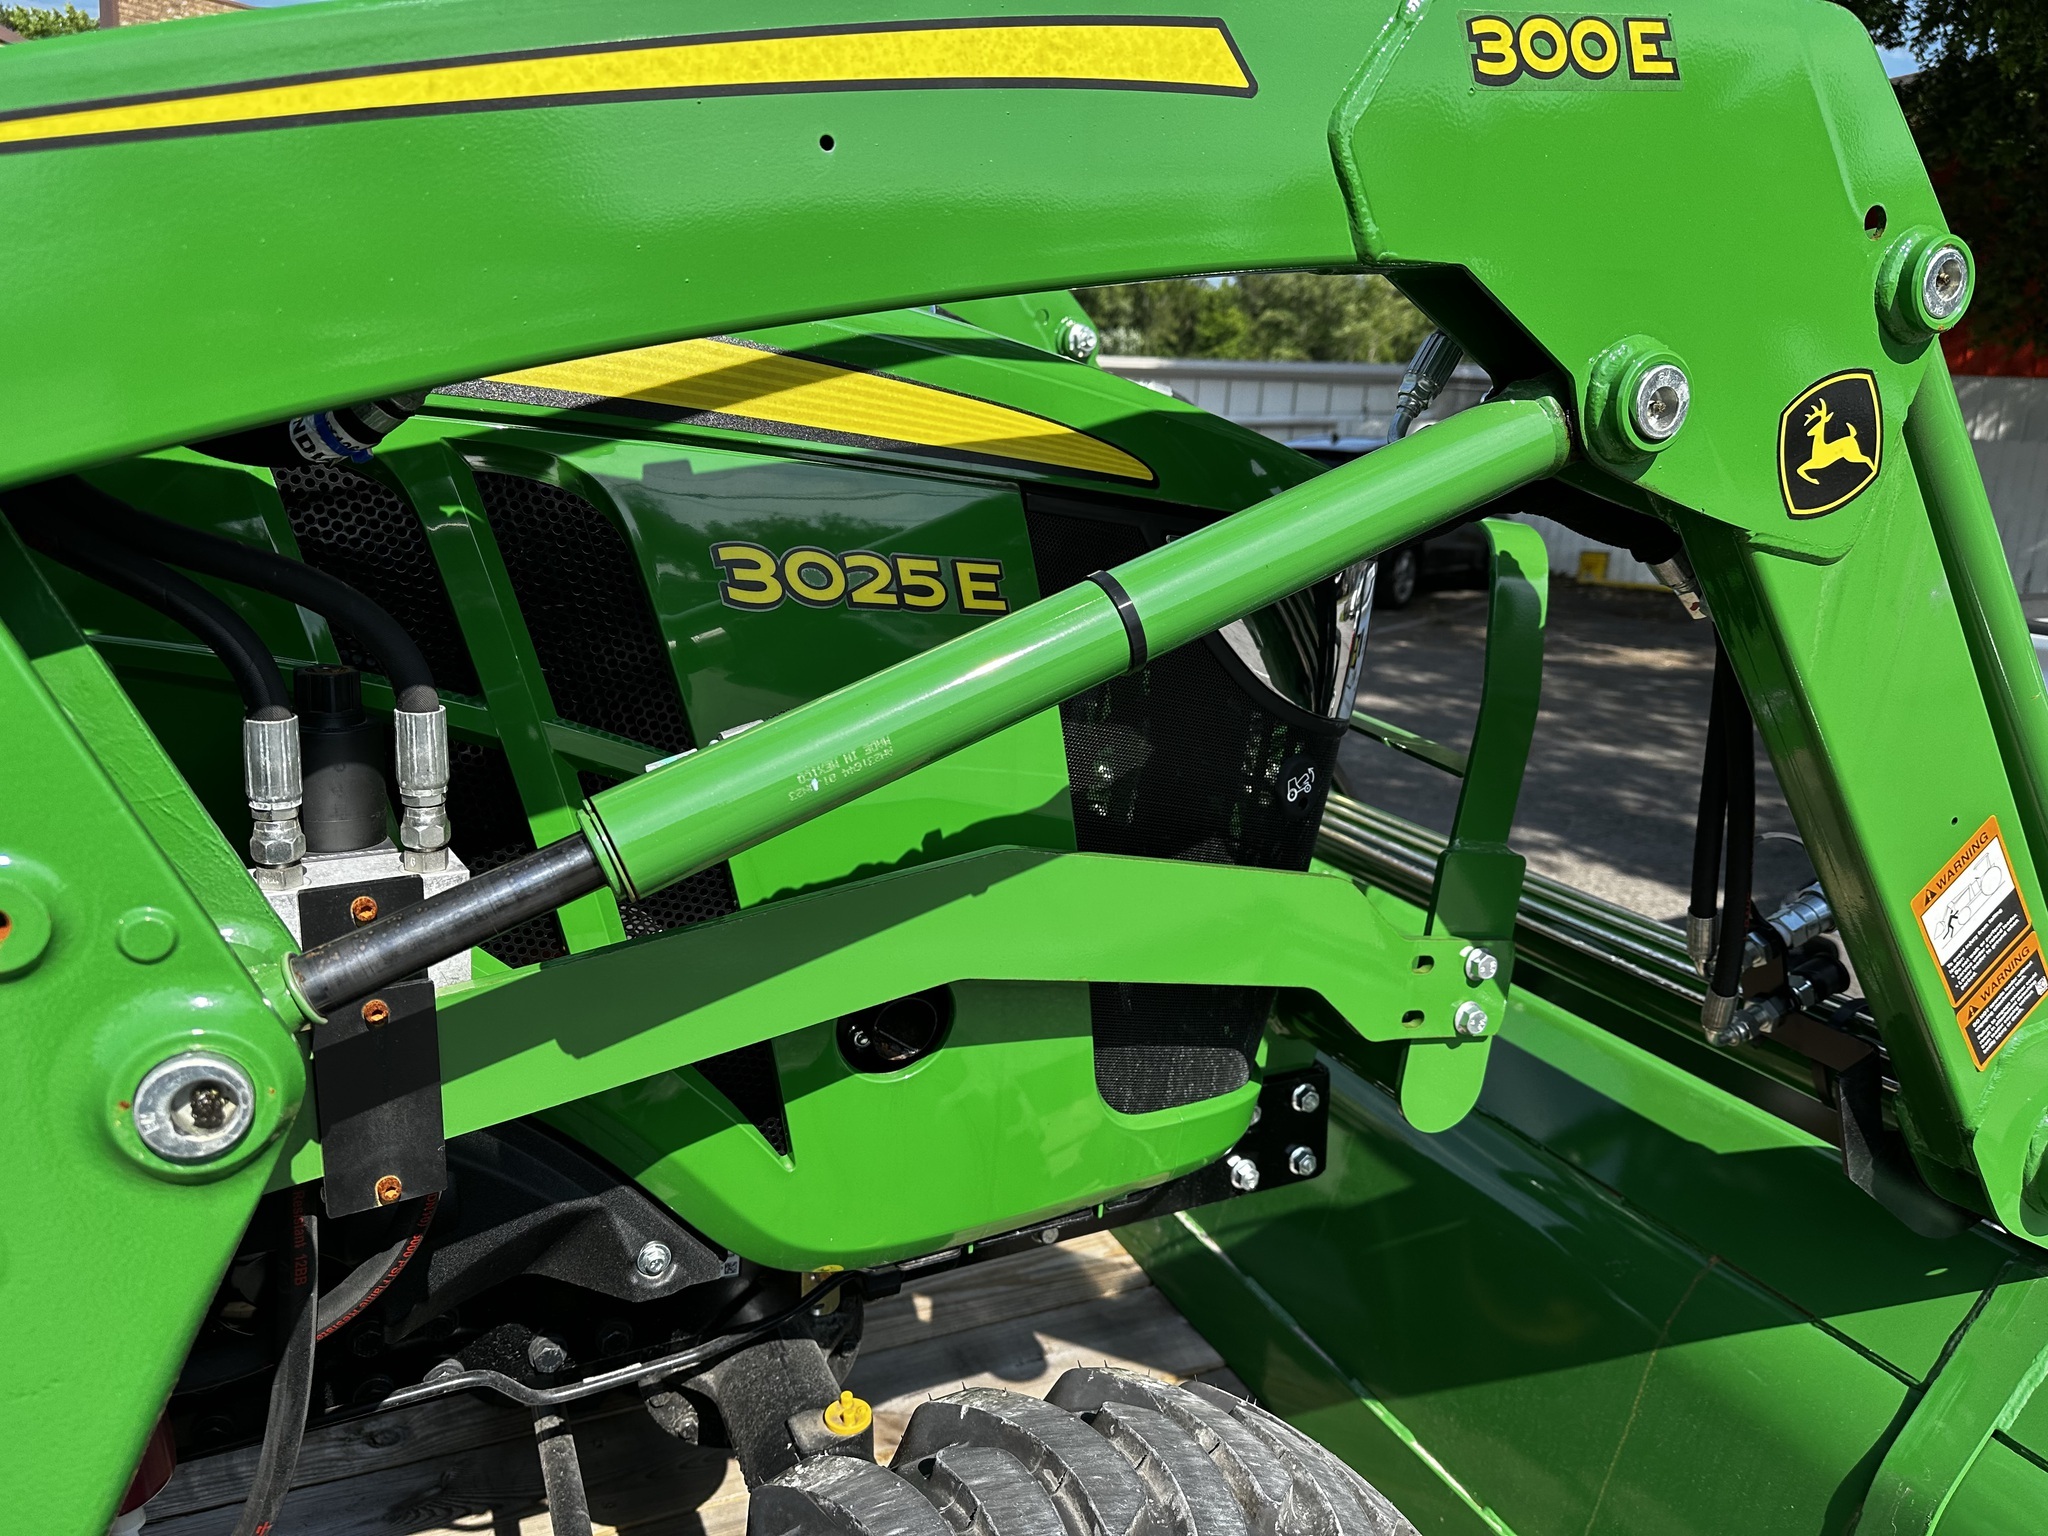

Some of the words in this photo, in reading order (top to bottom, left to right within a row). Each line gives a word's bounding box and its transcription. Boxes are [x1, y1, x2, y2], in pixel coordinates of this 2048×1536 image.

[843, 750, 858, 764] IN
[1935, 831, 1989, 890] WARNING
[1980, 946, 2030, 1001] WARNING
[293, 1191, 305, 1249] Resistant
[295, 1255, 308, 1286] 12BB
